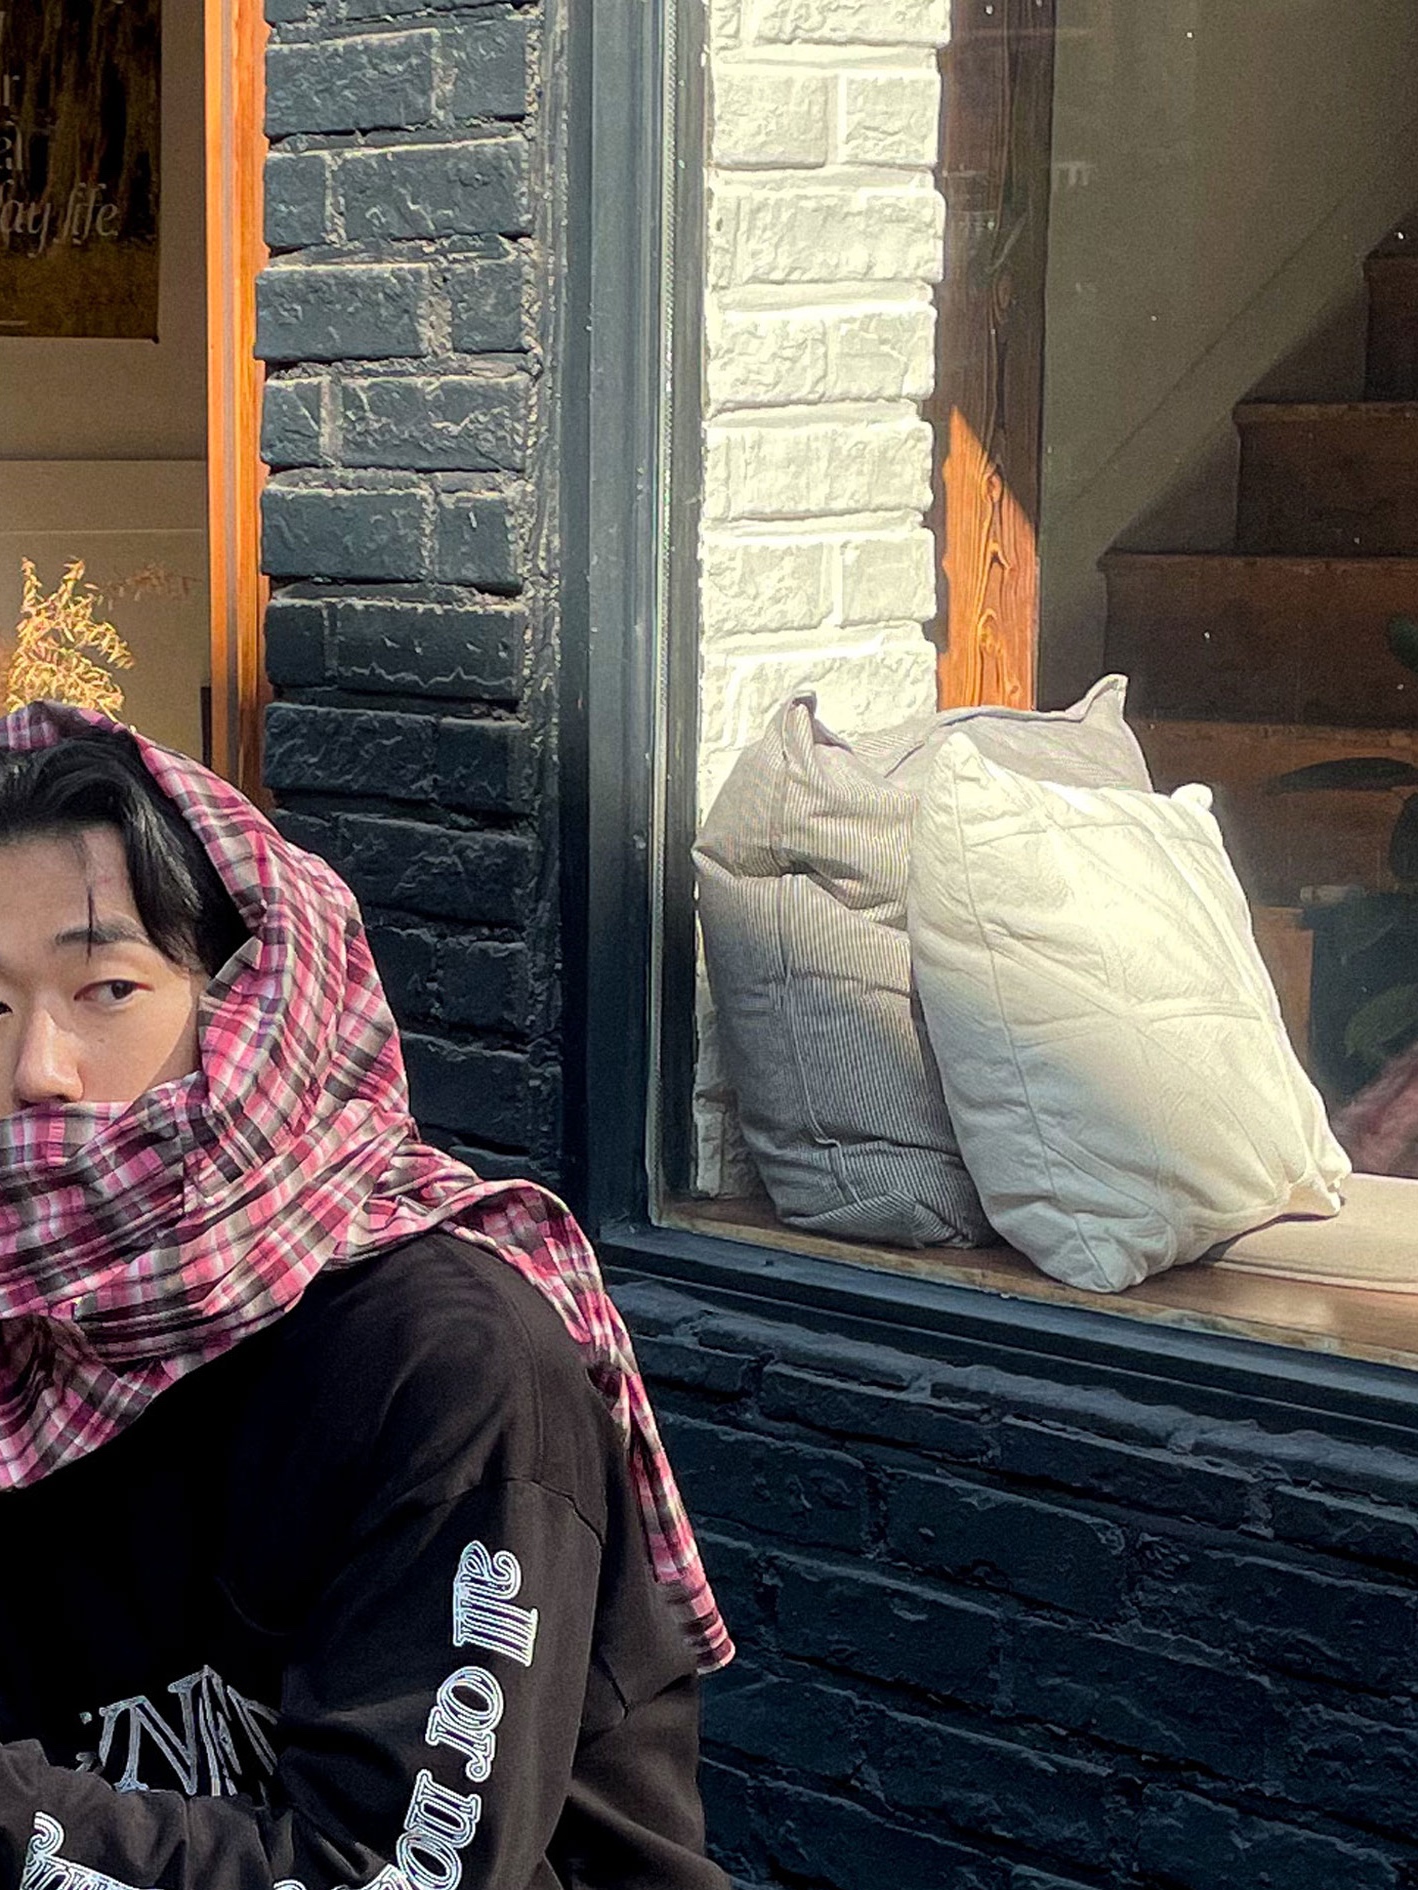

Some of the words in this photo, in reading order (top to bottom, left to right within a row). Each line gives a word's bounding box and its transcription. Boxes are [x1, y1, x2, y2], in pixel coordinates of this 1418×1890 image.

[53, 182, 120, 246] life
[452, 1539, 540, 1667] all
[425, 1665, 505, 1783] or
